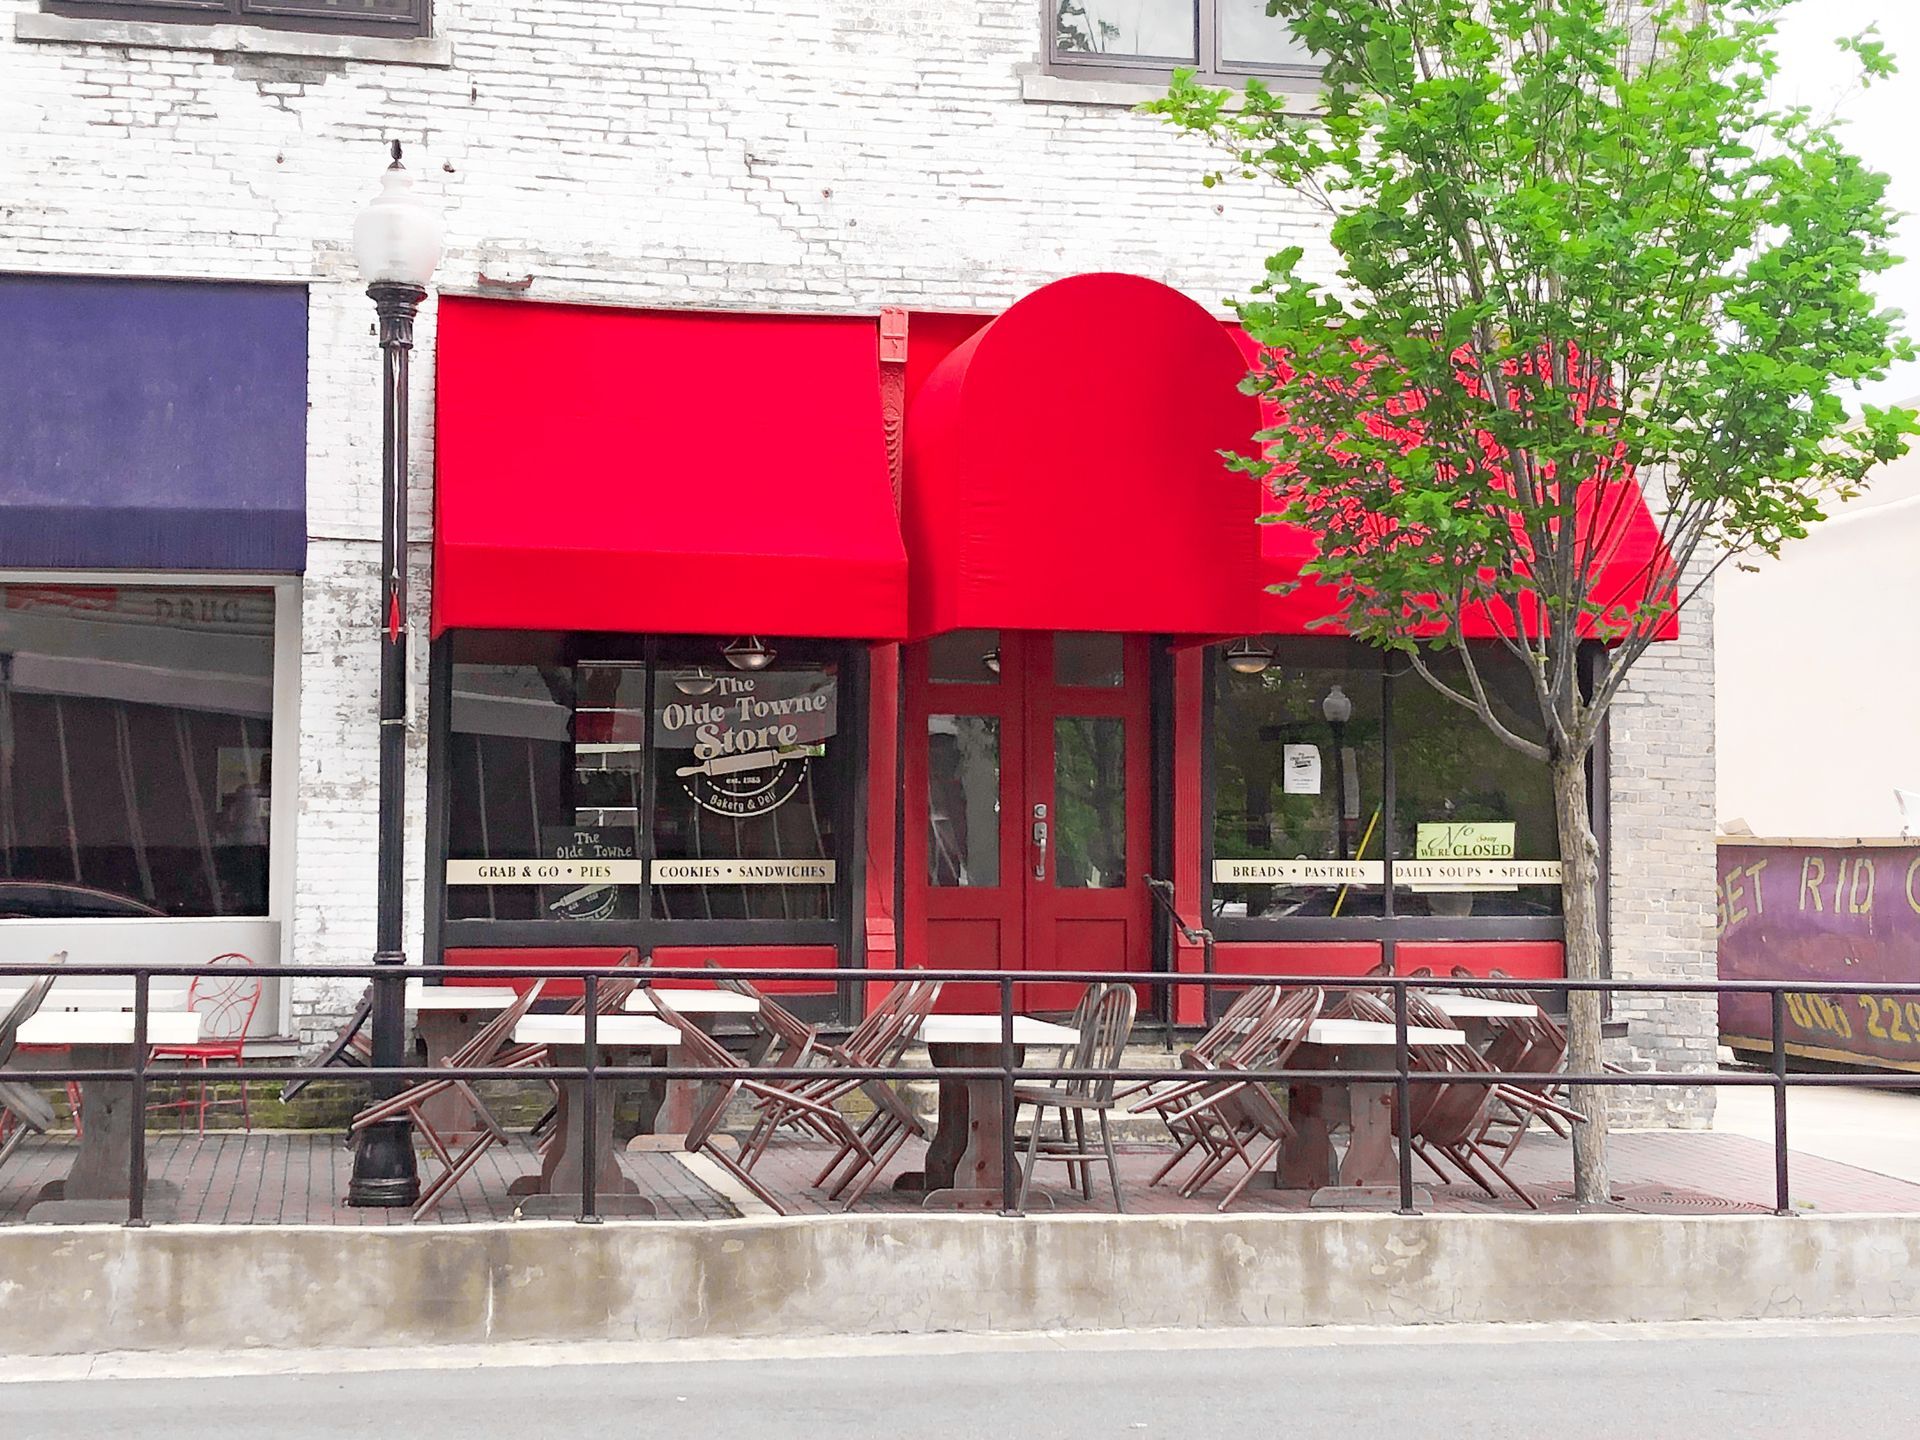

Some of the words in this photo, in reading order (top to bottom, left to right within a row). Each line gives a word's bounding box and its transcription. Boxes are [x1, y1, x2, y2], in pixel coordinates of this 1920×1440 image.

[715, 677, 755, 695] The
[663, 703, 725, 730] Olde
[736, 695, 827, 722] Towne
[694, 724, 798, 760] Store
[710, 794, 744, 812] Bakery
[747, 799, 756, 809] &
[757, 791, 777, 806] Deli
[574, 832, 599, 845] The
[556, 846, 584, 858] Olde
[593, 845, 632, 857] Towne
[1453, 844, 1511, 857] CLOSED
[478, 866, 516, 878] GRAB
[522, 866, 532, 878] &
[538, 866, 559, 878] GO
[580, 866, 611, 878] PIES
[659, 865, 720, 878] COOKIES
[739, 865, 826, 878] SANDWICHES
[1232, 866, 1284, 878] BREADS
[1305, 866, 1365, 878] PASTRIES
[1395, 867, 1434, 878] DAILY
[1440, 866, 1481, 878] SOUPS
[1501, 866, 1562, 878] SPECIALS
[1800, 856, 1875, 914] RID
